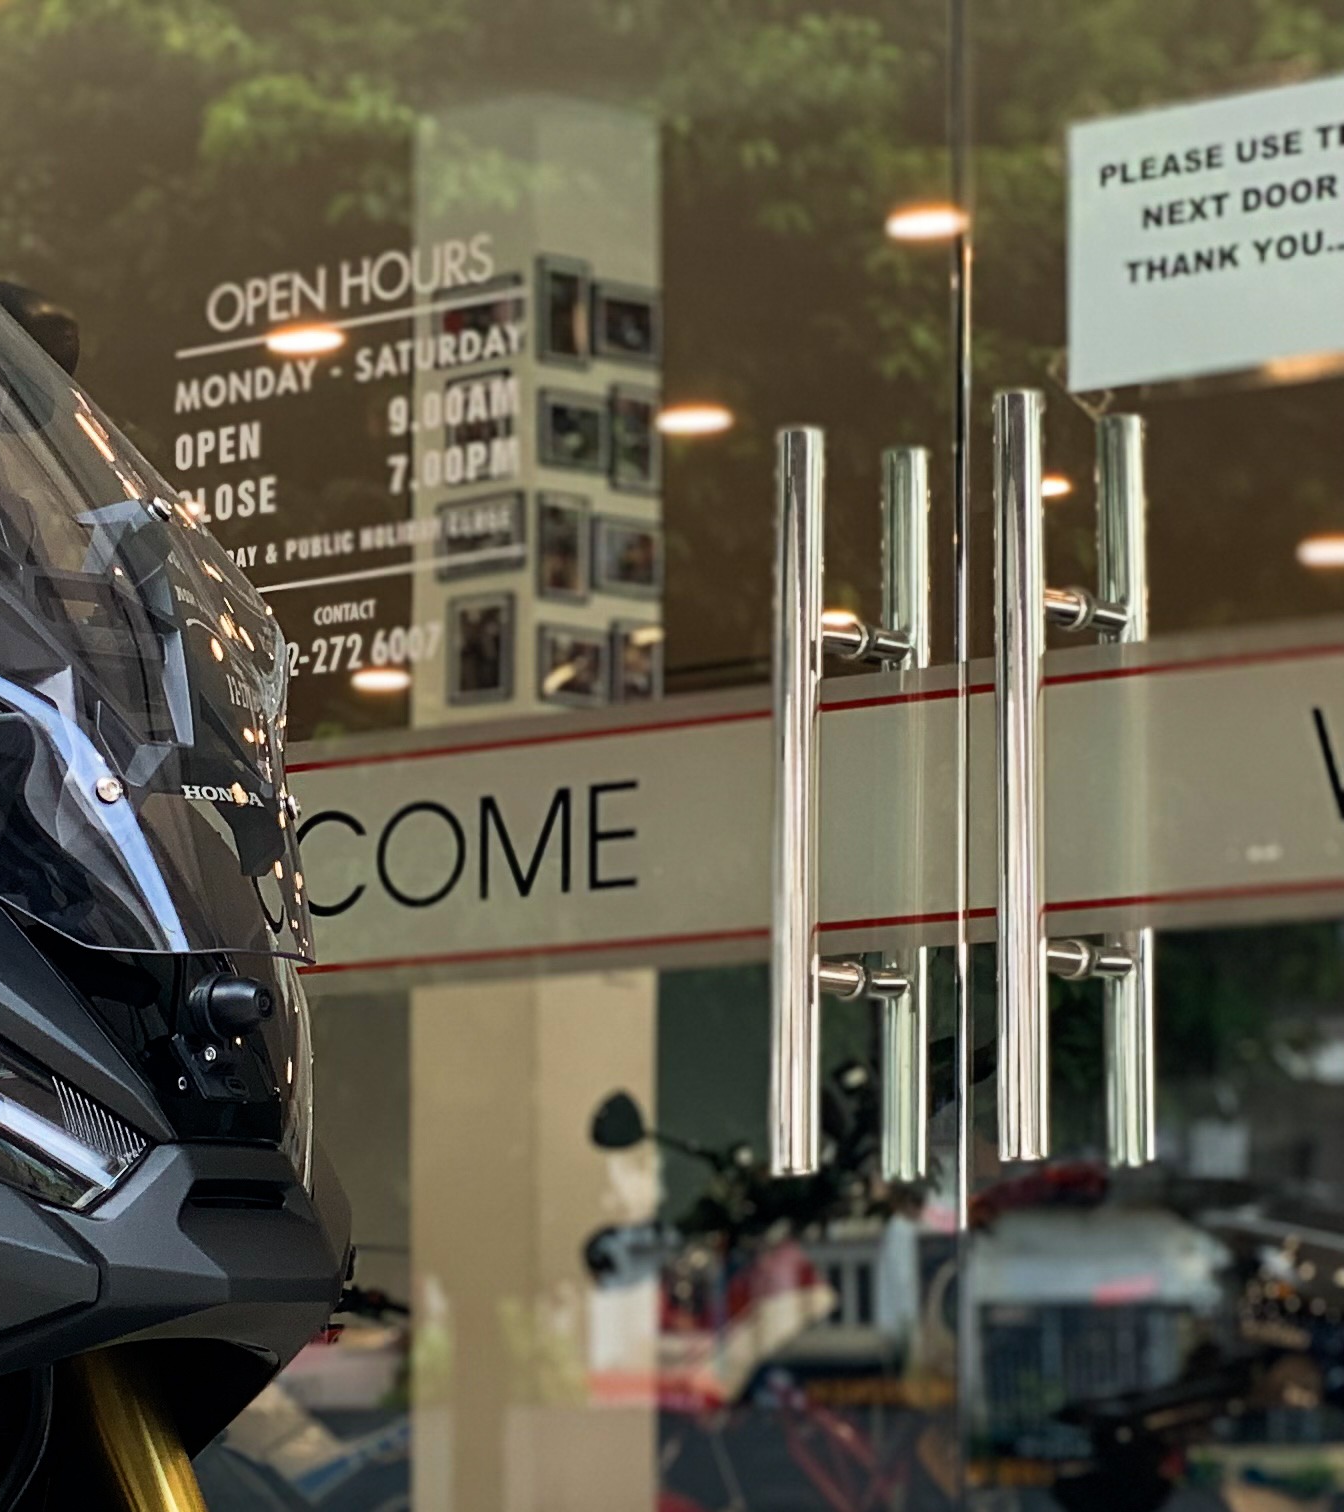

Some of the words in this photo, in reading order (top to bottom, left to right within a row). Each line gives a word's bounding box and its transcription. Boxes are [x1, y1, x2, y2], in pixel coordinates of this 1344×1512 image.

[1099, 144, 1223, 187] PLEASE
[1236, 131, 1303, 163] USE
[1141, 193, 1230, 229] NEXT
[1241, 174, 1337, 213] DOOR
[206, 262, 326, 332] OPEN
[341, 234, 495, 309] HOURS
[1126, 244, 1240, 284] THANK
[175, 359, 317, 412] MONDAY
[355, 326, 526, 381] SATURDAY
[175, 422, 261, 470] OPEN
[388, 375, 519, 436] 9.00AM
[387, 436, 519, 495] 7.00PM
[285, 530, 354, 560] PUBLIC
[314, 600, 376, 626] CONTACT
[181, 784, 265, 808] HONA
